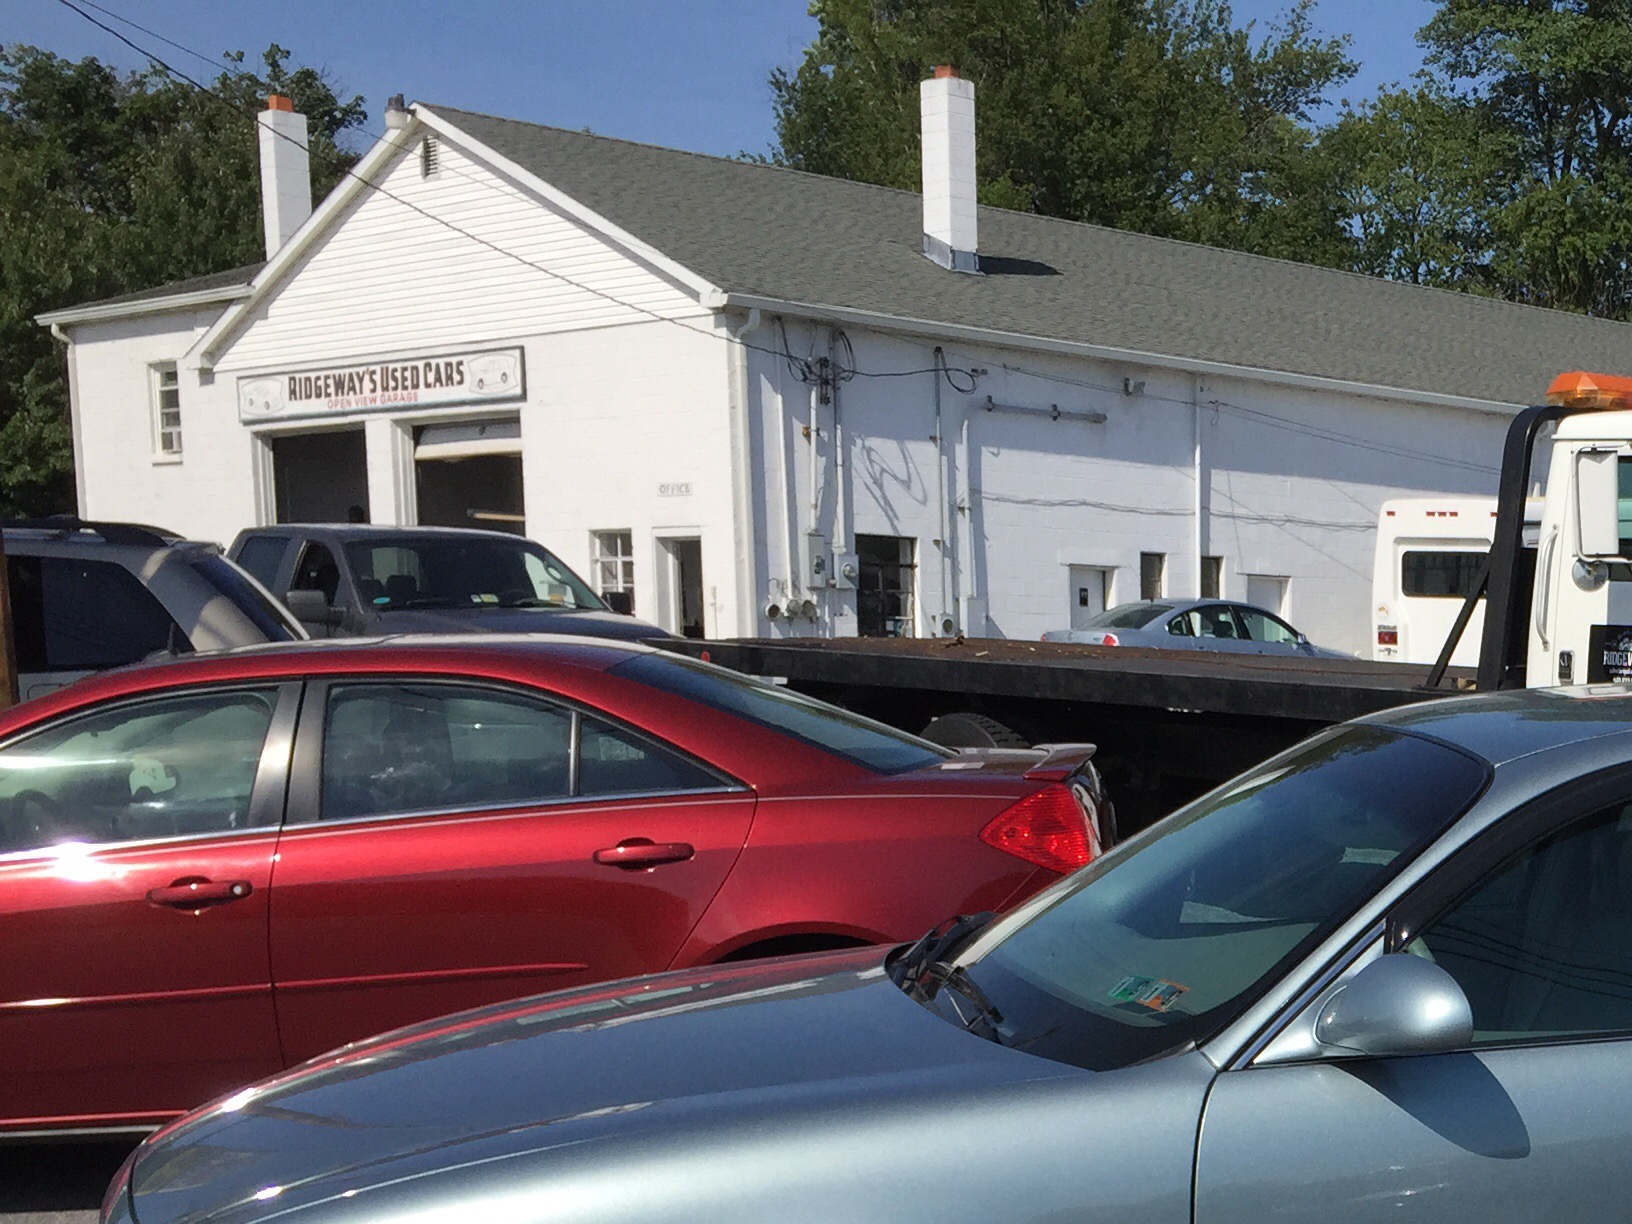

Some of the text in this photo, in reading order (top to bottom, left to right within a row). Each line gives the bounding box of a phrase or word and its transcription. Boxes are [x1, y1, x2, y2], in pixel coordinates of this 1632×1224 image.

[288, 360, 465, 401] RIDGEWAY'S USED CARS
[327, 392, 418, 409] OPEN VIEW GARAGE
[659, 483, 691, 494] OFFICE
